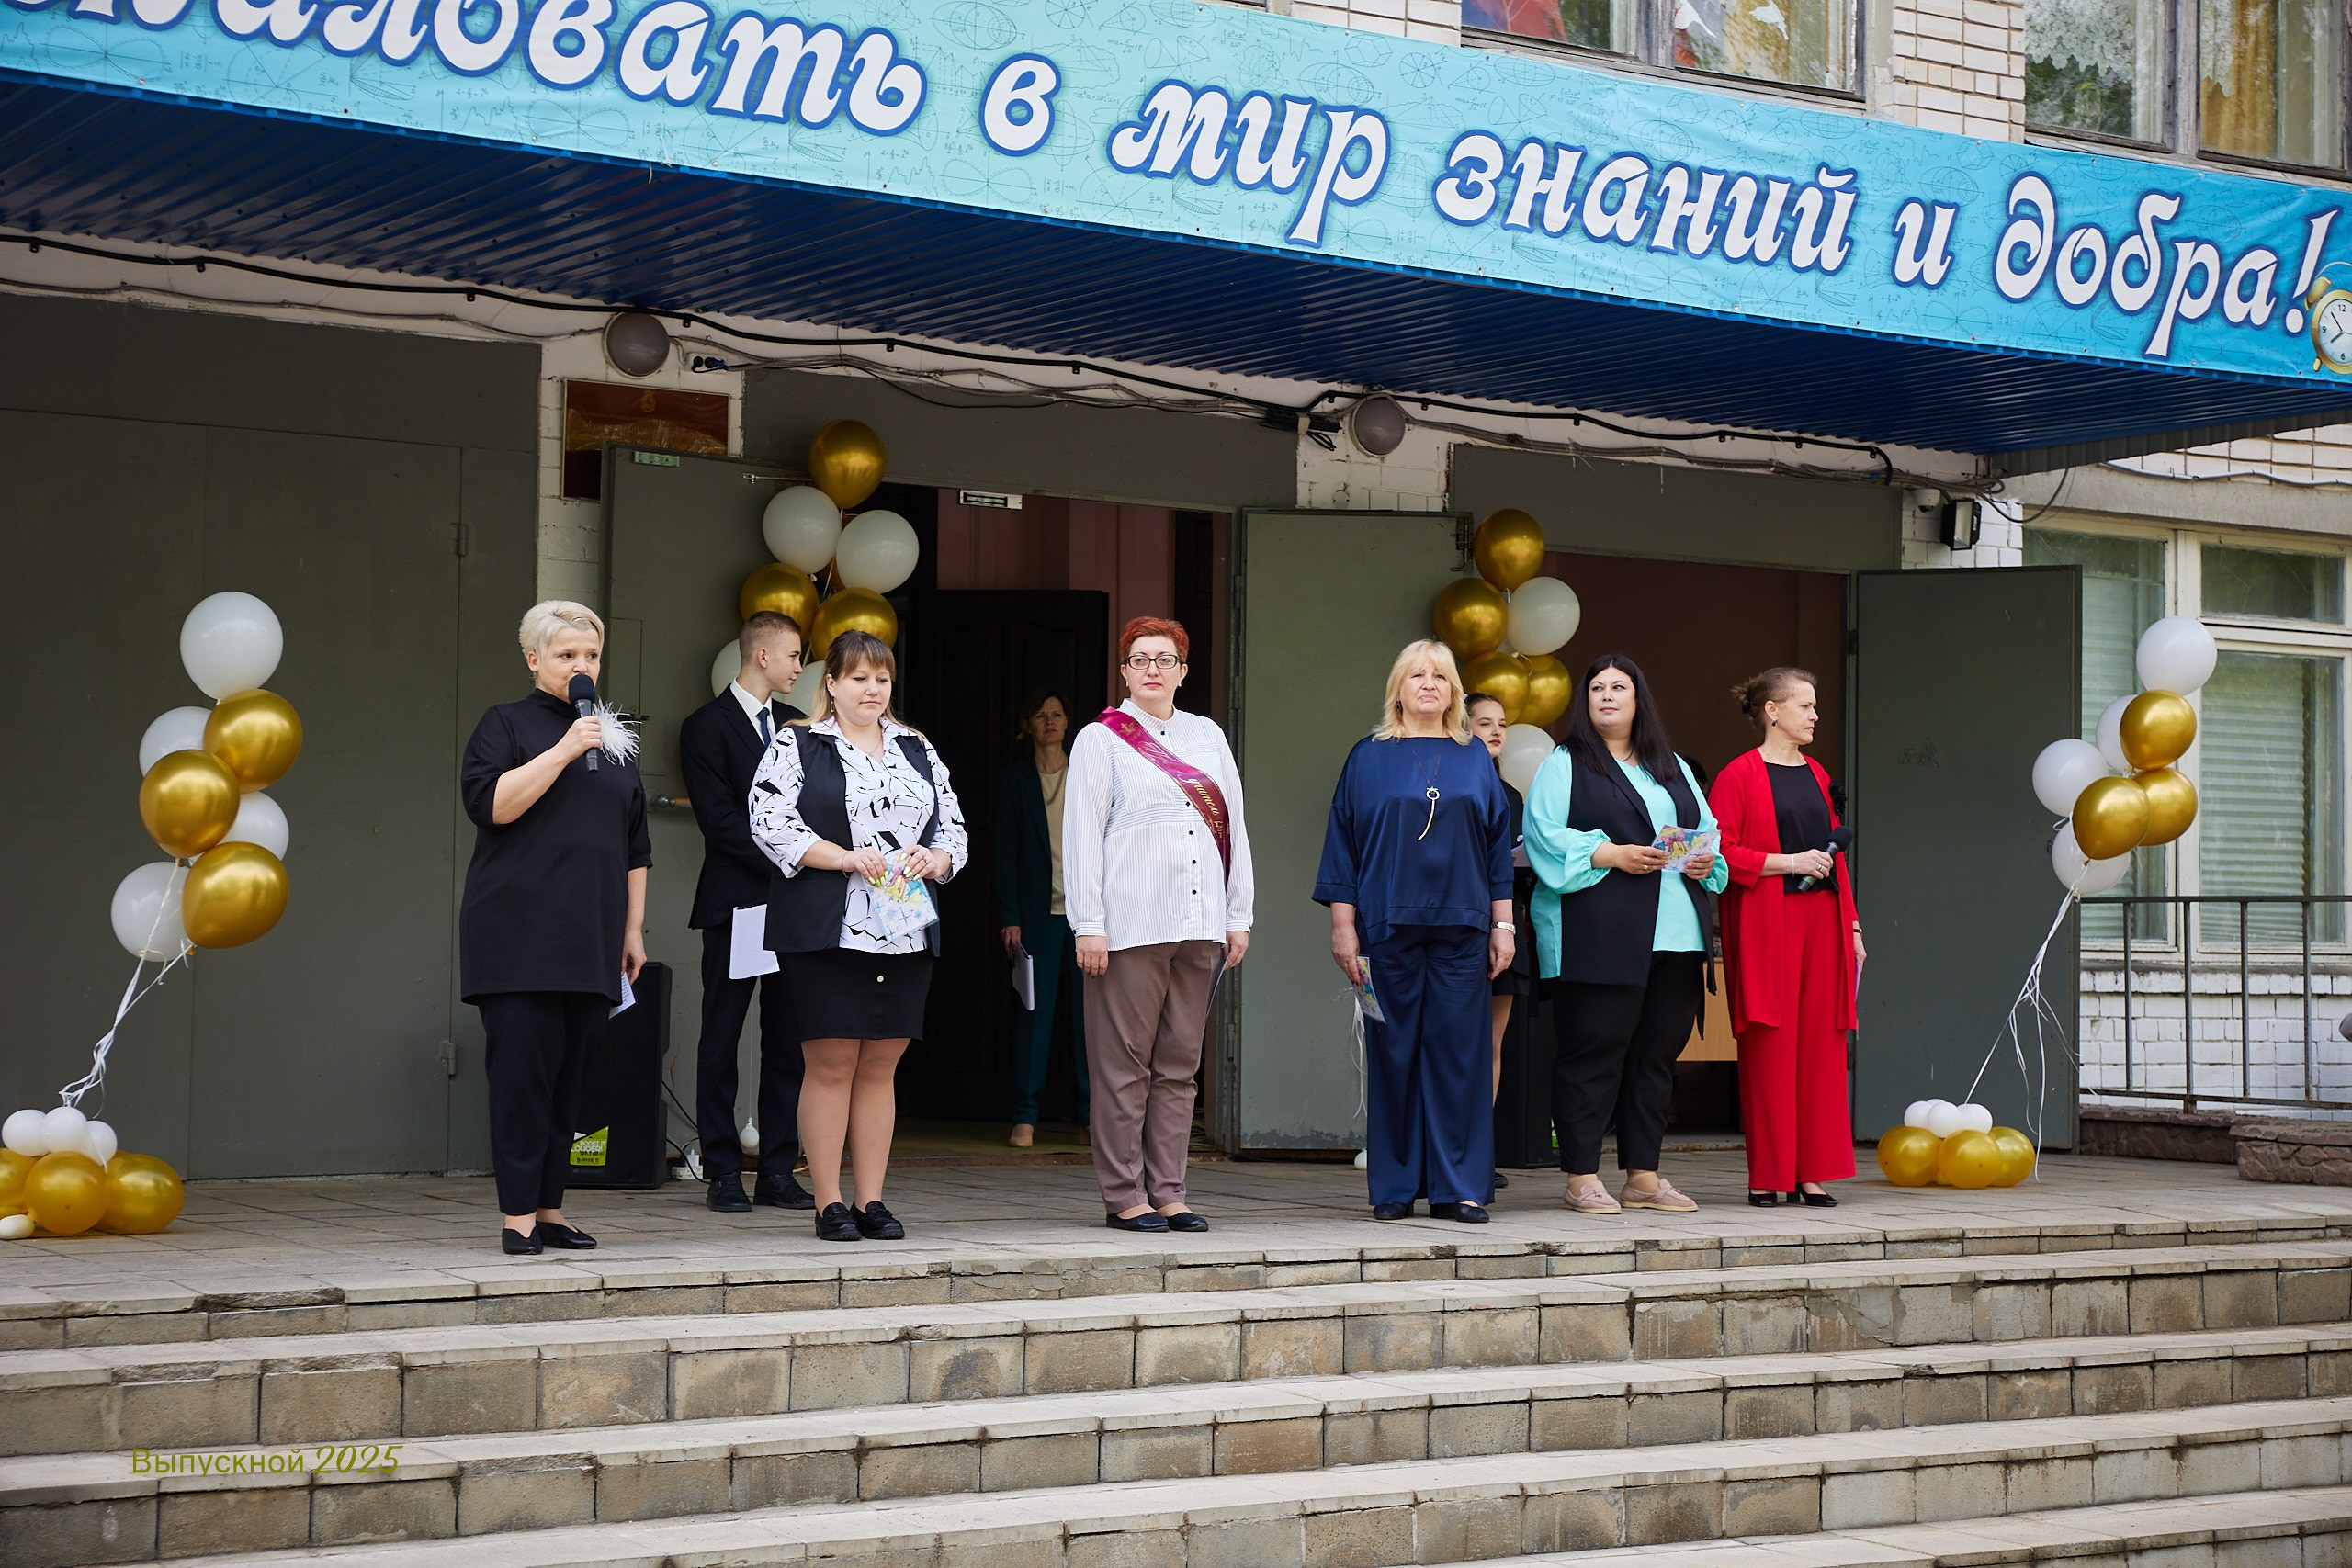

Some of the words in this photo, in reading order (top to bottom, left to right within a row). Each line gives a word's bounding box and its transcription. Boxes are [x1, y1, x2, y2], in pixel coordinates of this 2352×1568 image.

[979, 52, 1061, 157] в
[1107, 79, 1392, 248] мир
[1436, 129, 1859, 276] знаний
[1892, 197, 1960, 288] и
[1993, 171, 2344, 360] добра!
